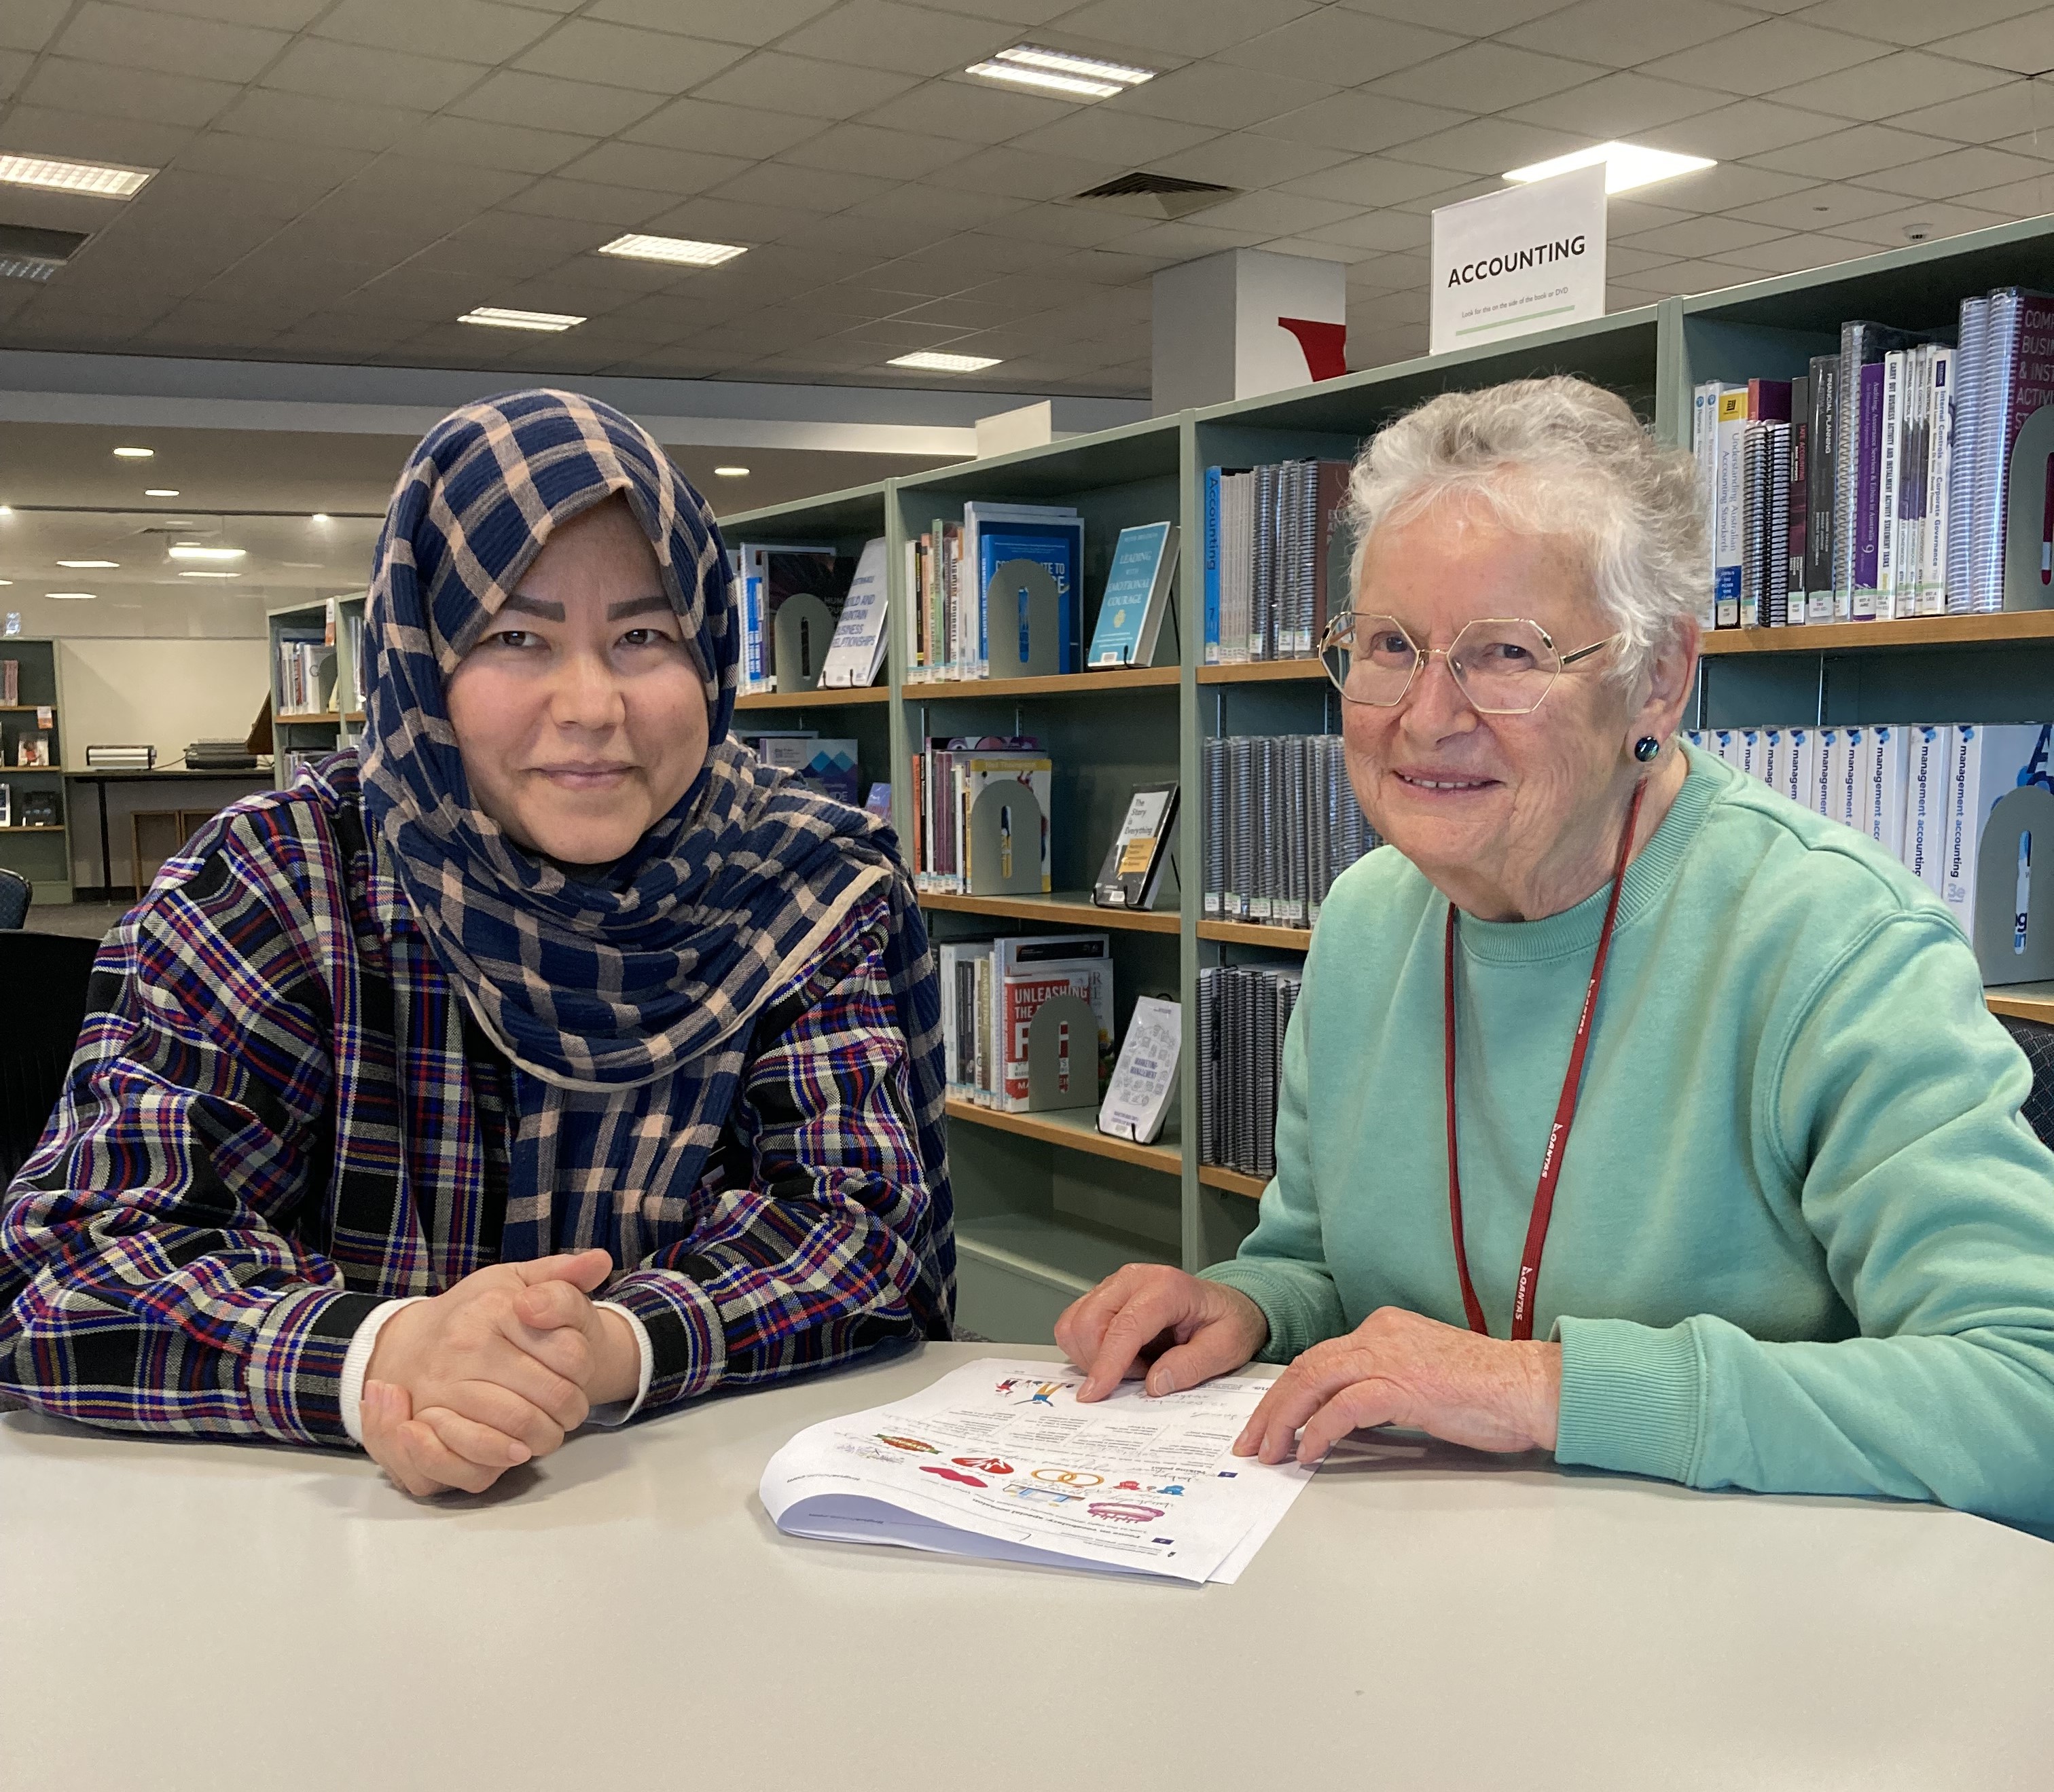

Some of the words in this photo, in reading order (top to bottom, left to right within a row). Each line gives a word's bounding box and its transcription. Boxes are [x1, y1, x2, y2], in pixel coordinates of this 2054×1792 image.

[1447, 236, 1585, 288] ACCOUNTING
[1534, 293, 1547, 301] book
[1555, 287, 1568, 296] DVD
[1889, 362, 1897, 380] CARRY
[2019, 361, 2028, 379] &
[1871, 382, 1880, 412] Auditing,
[1888, 395, 1896, 420] BUSINESS
[1871, 414, 1879, 446] Assurance
[1729, 433, 1740, 503] Understanding
[1870, 448, 1878, 474] Services
[1720, 451, 1729, 505] Accounting
[1934, 477, 1943, 517] Corporate
[1207, 477, 1219, 570] Accounting
[1720, 507, 1729, 553] Standards
[1730, 505, 1740, 551] Australian
[1119, 551, 1152, 564] LEADING
[1862, 544, 1875, 553] 9
[1055, 562, 1066, 575] TO
[1108, 579, 1151, 592] EMOTIONAL
[1107, 594, 1142, 607] COURAGE
[1790, 750, 1799, 800] managem
[1845, 750, 1855, 818] management
[1873, 748, 1884, 817] management
[1917, 746, 1928, 817] management
[1956, 746, 1966, 817] management
[1130, 808, 1147, 817] Story
[1135, 799, 1145, 807] The
[1124, 827, 1153, 837] Everything
[1950, 820, 1962, 877] accounting
[1014, 985, 1087, 1004] UNLEASHING
[1014, 1006, 1034, 1019] THE
[1130, 1066, 1157, 1080] MANAGEMENT
[1541, 1133, 1557, 1180] QANTAS
[1514, 1276, 1528, 1322] QANTAS
[1011, 1510, 1044, 1520] special
